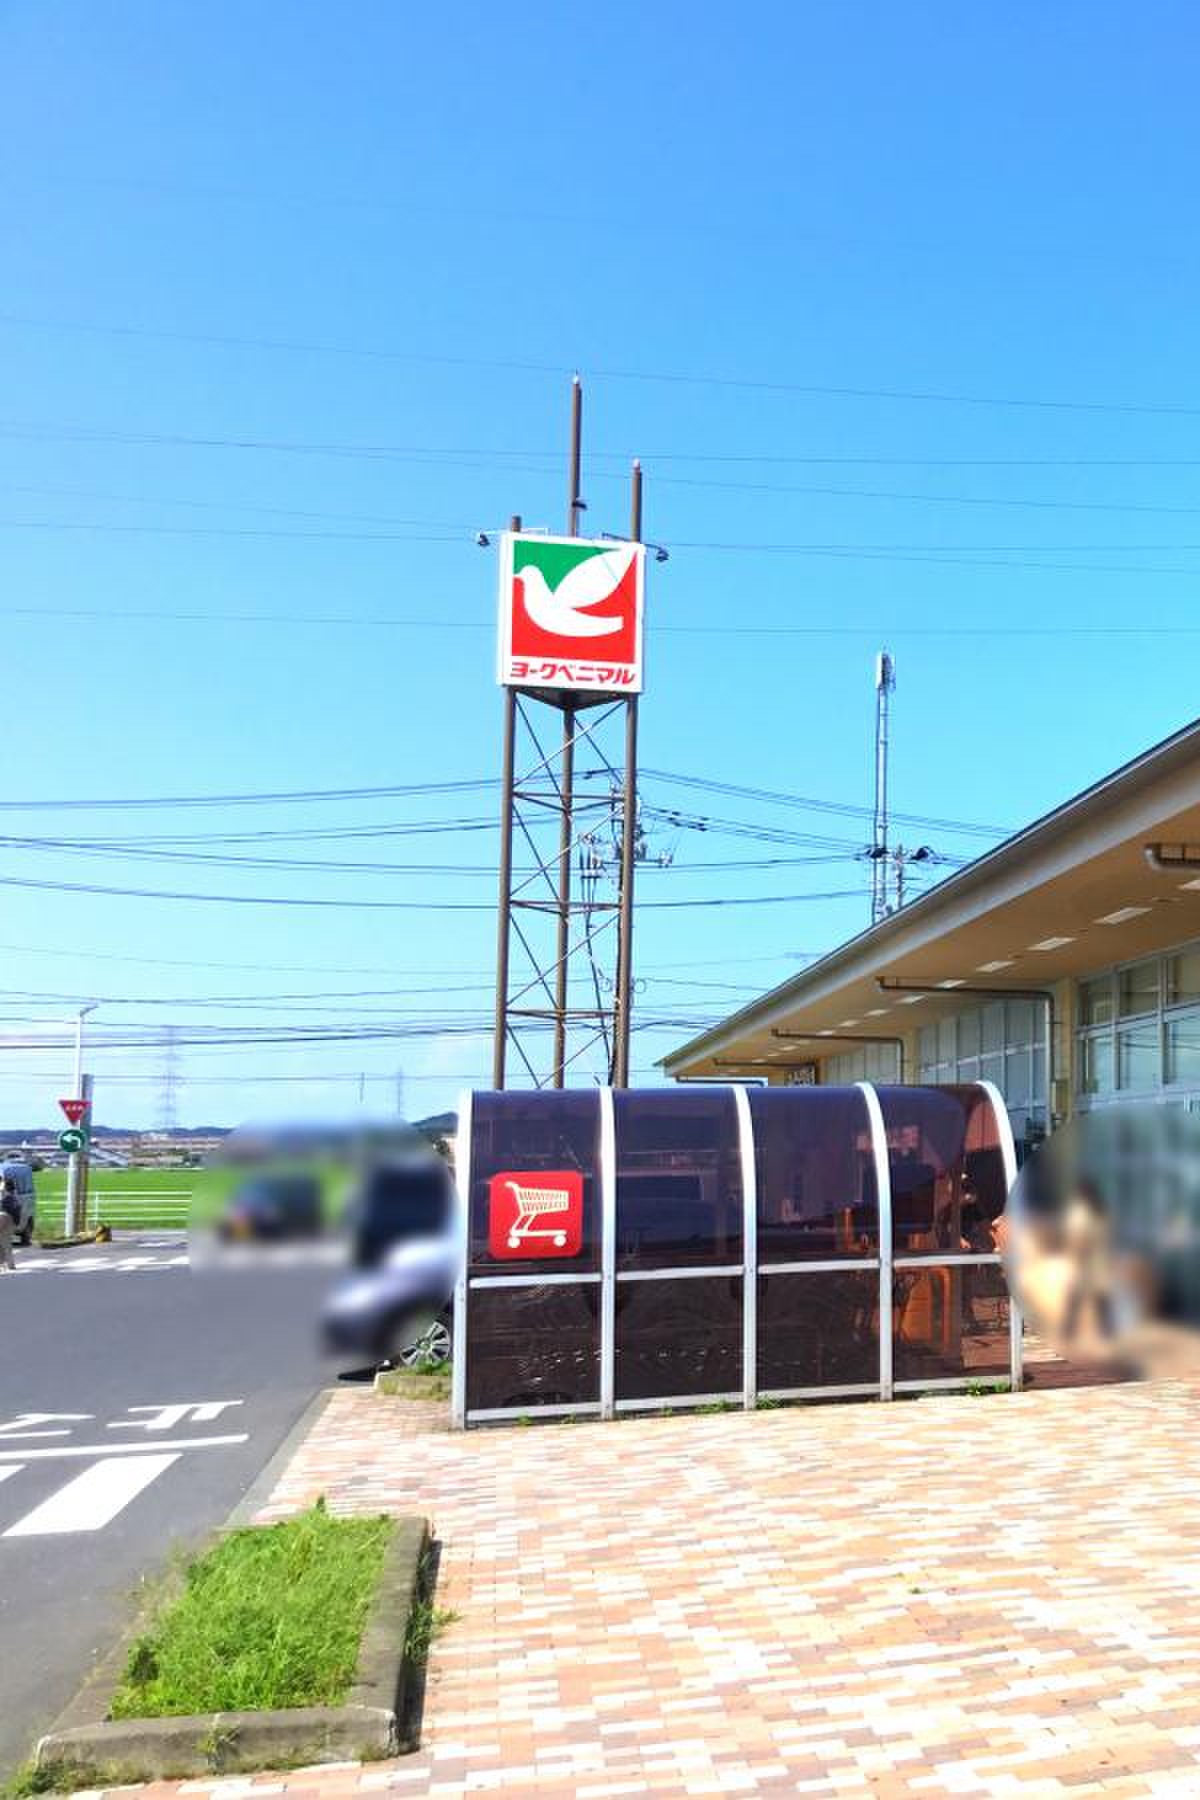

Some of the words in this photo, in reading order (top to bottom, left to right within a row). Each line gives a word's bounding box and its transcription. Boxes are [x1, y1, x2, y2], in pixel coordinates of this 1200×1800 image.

[510, 661, 635, 685] ヨークベニマル
